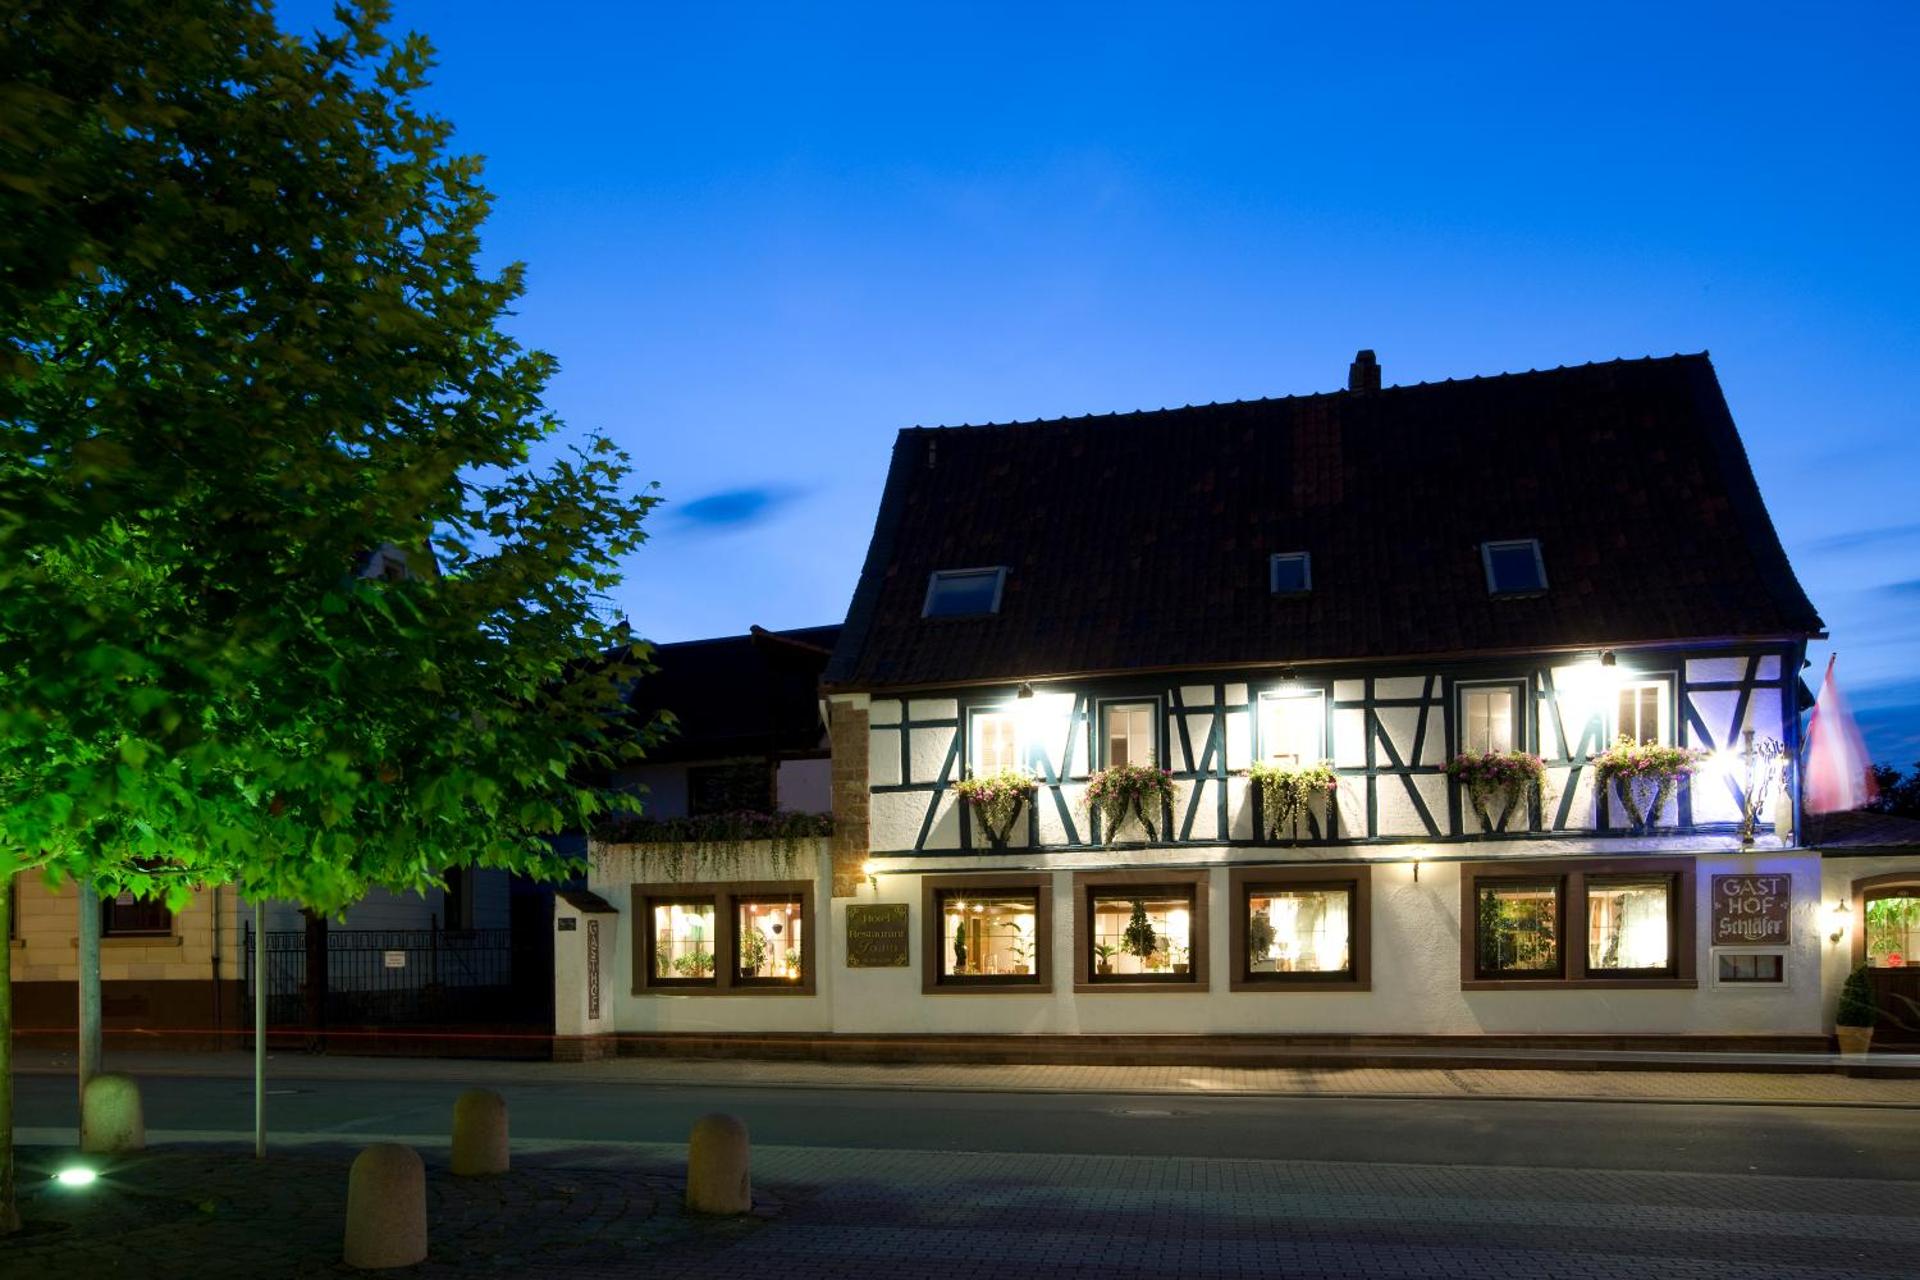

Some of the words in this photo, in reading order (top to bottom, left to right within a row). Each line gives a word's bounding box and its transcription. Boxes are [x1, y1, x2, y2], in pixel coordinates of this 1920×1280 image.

[1723, 878, 1780, 896] GAST
[1728, 897, 1775, 914] HOF
[849, 929, 905, 938] Restaurant
[589, 920, 599, 1010] GASTHOF
